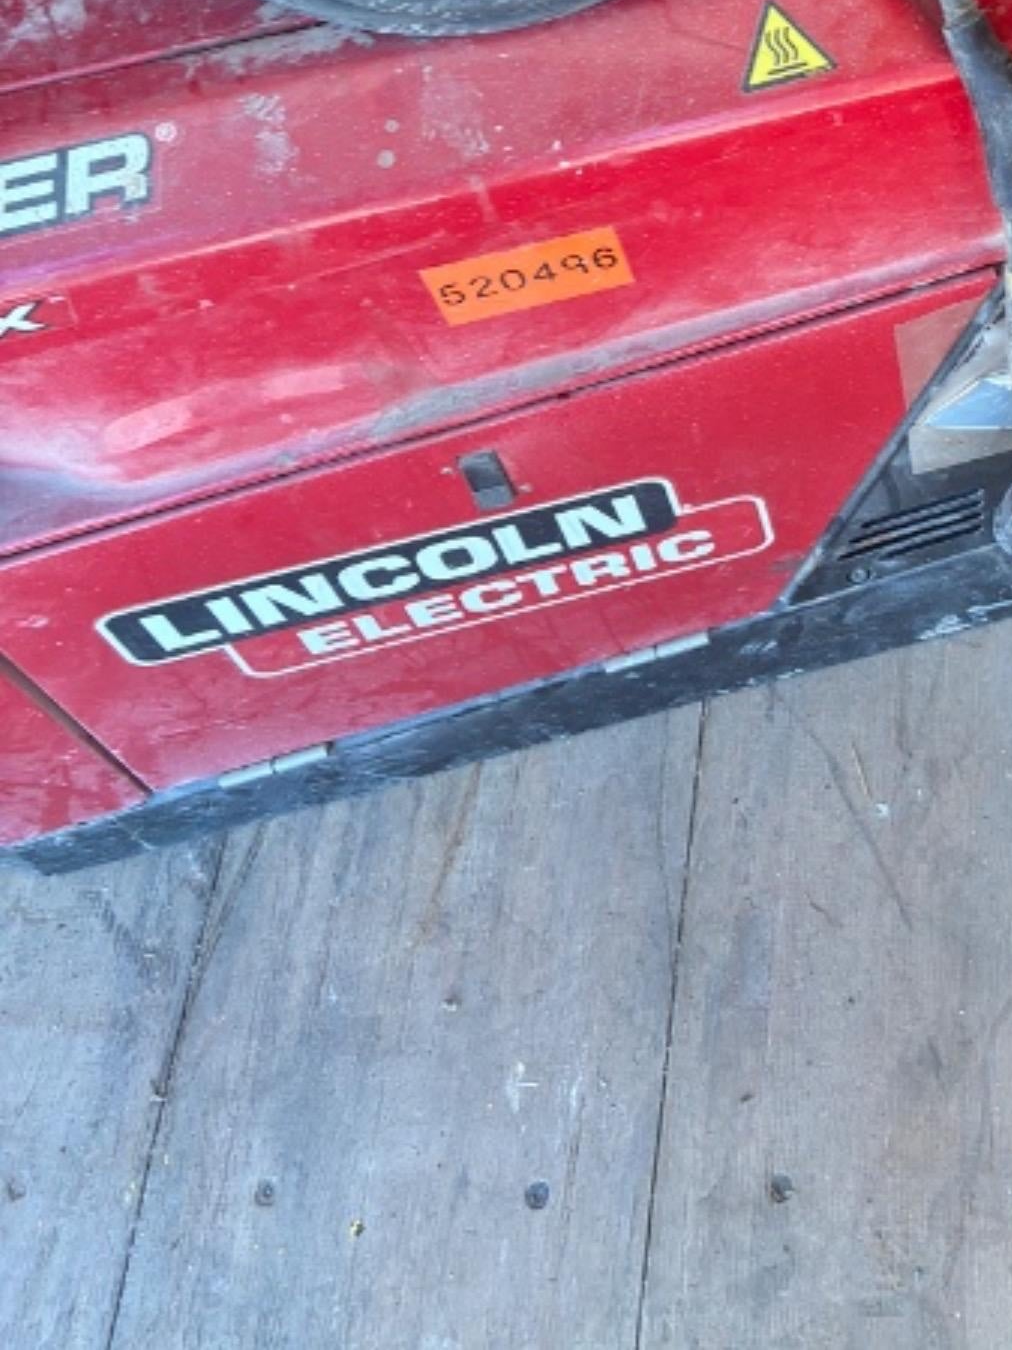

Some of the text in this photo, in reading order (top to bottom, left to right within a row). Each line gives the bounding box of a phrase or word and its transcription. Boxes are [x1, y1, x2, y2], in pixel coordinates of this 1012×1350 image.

[439, 247, 619, 306] 520496
[139, 494, 646, 652] LINCOLN
[296, 529, 715, 655] ELECTRIC
